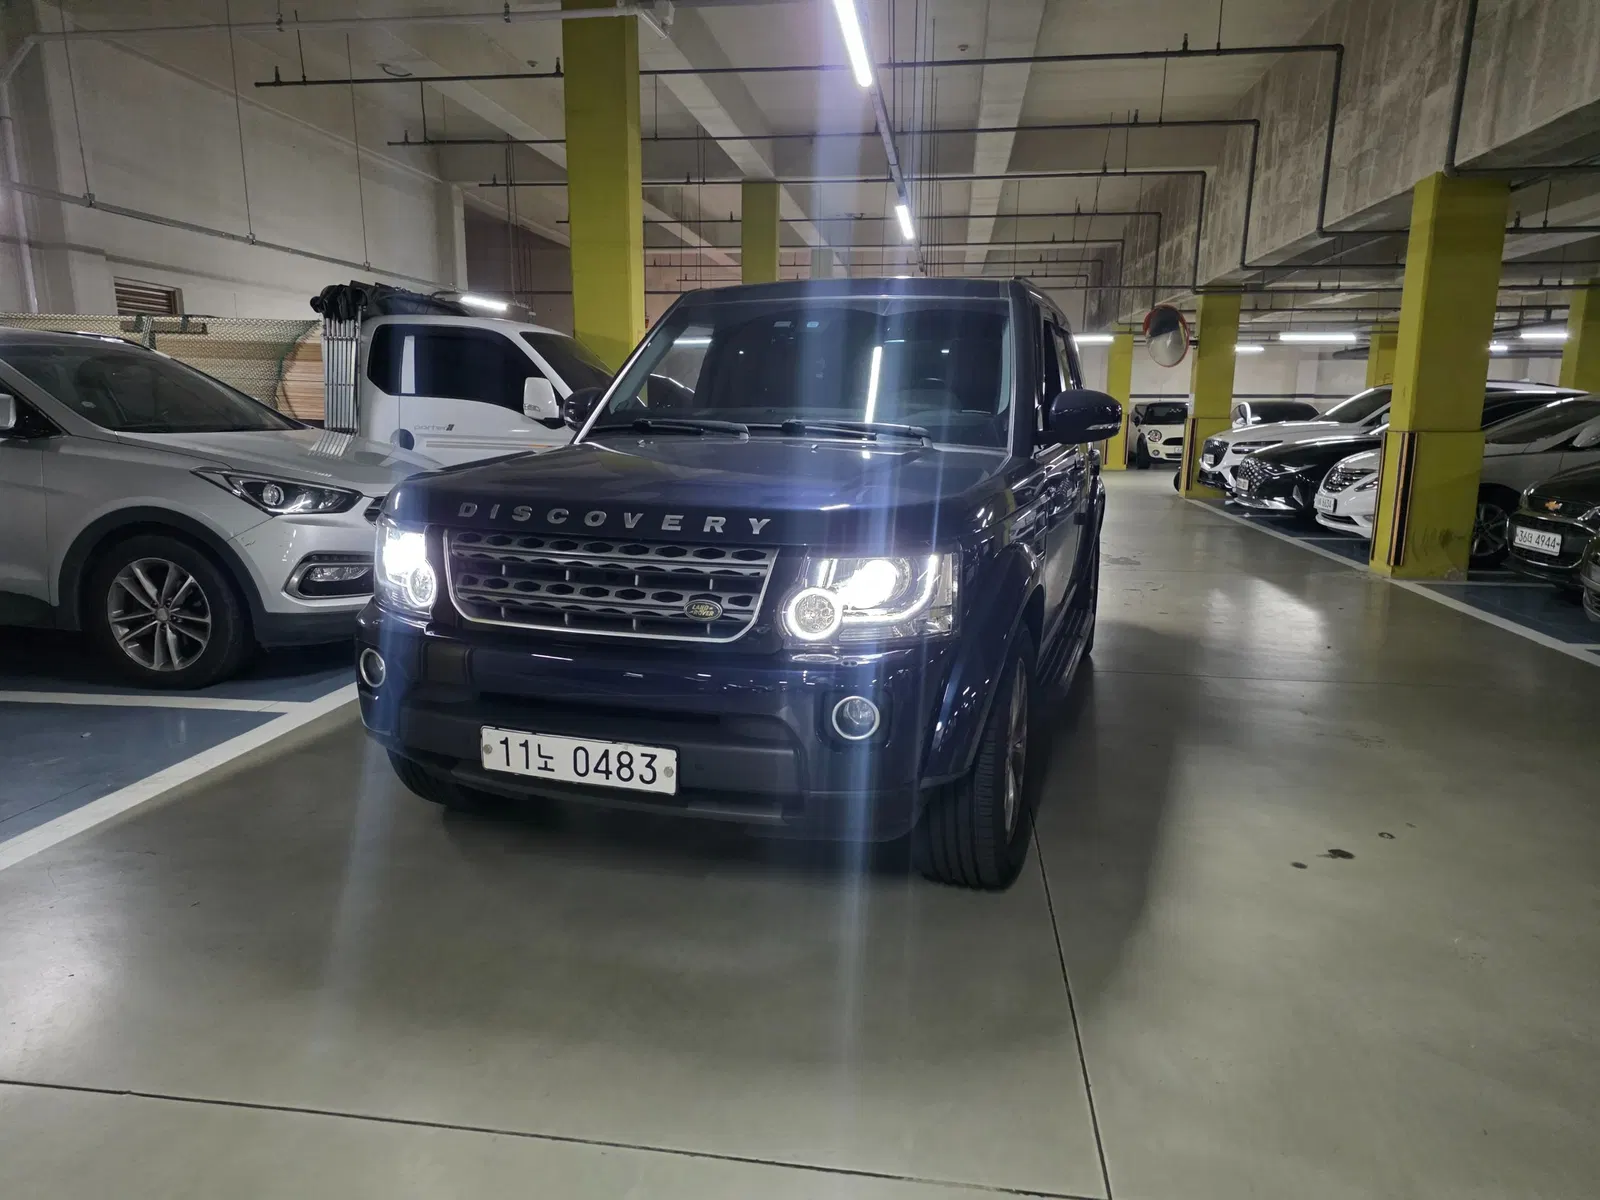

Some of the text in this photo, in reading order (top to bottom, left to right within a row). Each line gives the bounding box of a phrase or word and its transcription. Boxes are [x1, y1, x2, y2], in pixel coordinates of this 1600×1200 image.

[457, 502, 771, 535] DISCOVERY
[1535, 535, 1556, 549] 4944
[499, 736, 658, 786] 11노 0483
